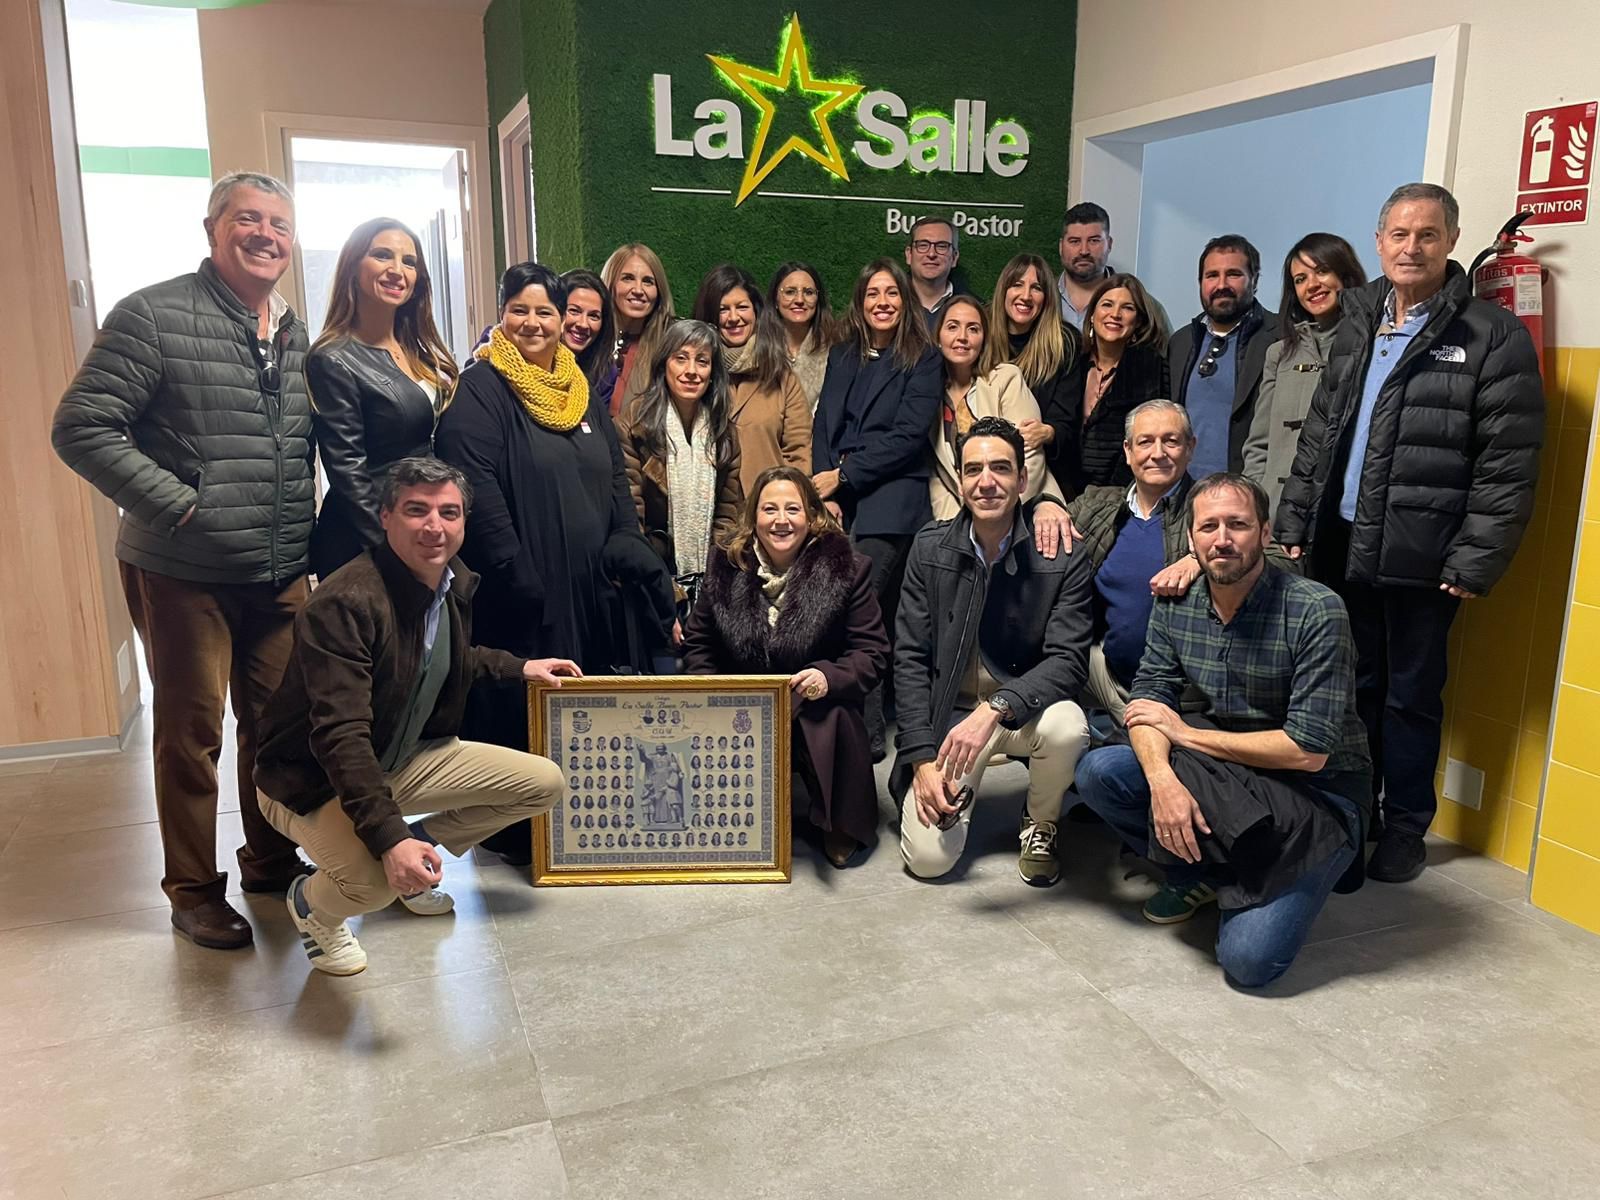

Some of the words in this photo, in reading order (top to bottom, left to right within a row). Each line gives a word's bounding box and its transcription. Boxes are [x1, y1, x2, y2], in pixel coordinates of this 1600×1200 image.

[653, 73, 744, 160] La
[853, 90, 1030, 177] Salle
[1521, 199, 1583, 214] EXTINTOR
[886, 208, 928, 234] Bu
[952, 210, 1024, 237] Pastor
